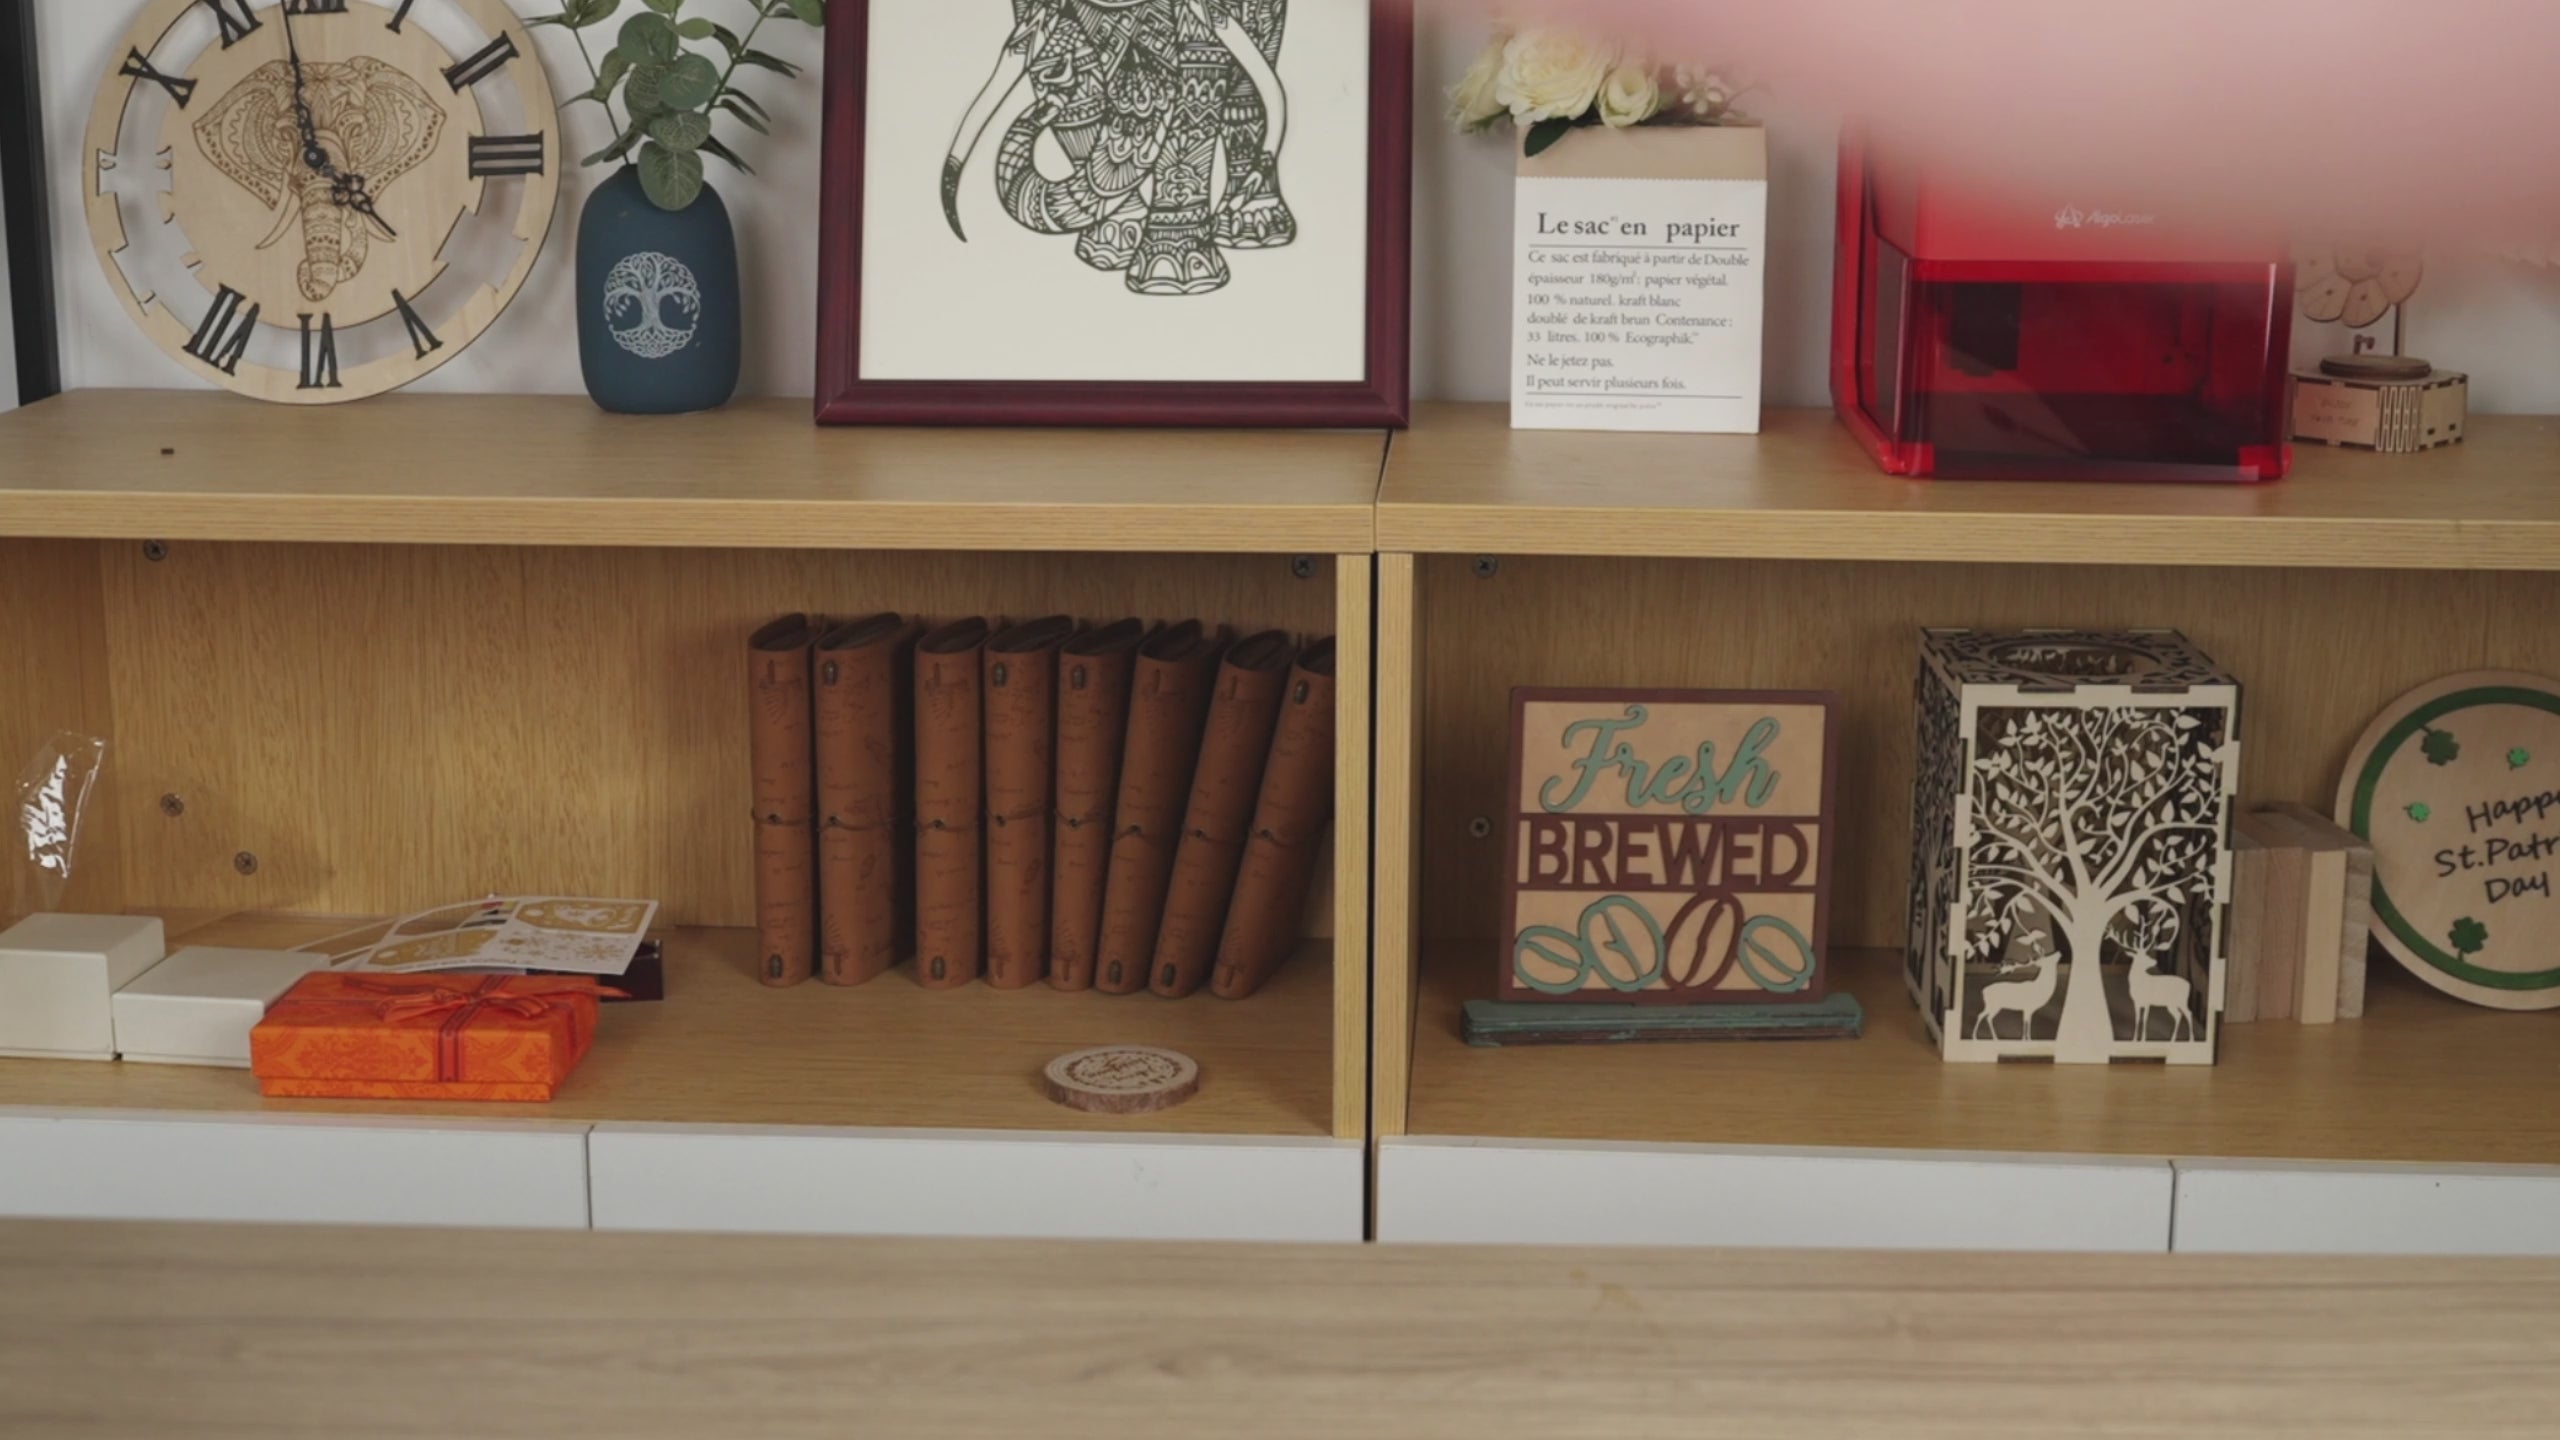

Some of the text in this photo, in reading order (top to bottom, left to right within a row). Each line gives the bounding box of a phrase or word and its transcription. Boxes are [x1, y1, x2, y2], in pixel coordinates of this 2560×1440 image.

[118, 45, 198, 110] X
[1537, 212, 1569, 235] Le
[1620, 222, 1647, 236] en
[1666, 217, 1740, 243] papier
[1528, 250, 1750, 267] Ce sac est fabriqué à partir de Double
[1528, 273, 1584, 287] épaisseur
[1644, 273, 1682, 288] papier
[1527, 293, 1550, 305] 100
[1554, 294, 1567, 305] %
[1618, 293, 1647, 307] kraft
[1649, 294, 1682, 307] blanc
[1573, 312, 1588, 325] de
[1590, 312, 1618, 326] kraft
[1621, 313, 1650, 326] brun
[1527, 331, 1541, 343] 33
[1584, 331, 1606, 343] 100
[1608, 331, 1620, 343] %
[1527, 353, 1546, 367] Ne
[1548, 353, 1560, 367] le
[1560, 354, 1588, 369] jetez
[1537, 377, 1565, 390] peut
[1567, 377, 1602, 388] servir
[1604, 375, 1659, 391] plusieurs
[1539, 704, 1781, 814] Fresh
[2465, 789, 2560, 834] Happ
[1528, 820, 1809, 886] BREWED
[2484, 871, 2550, 904] Day
